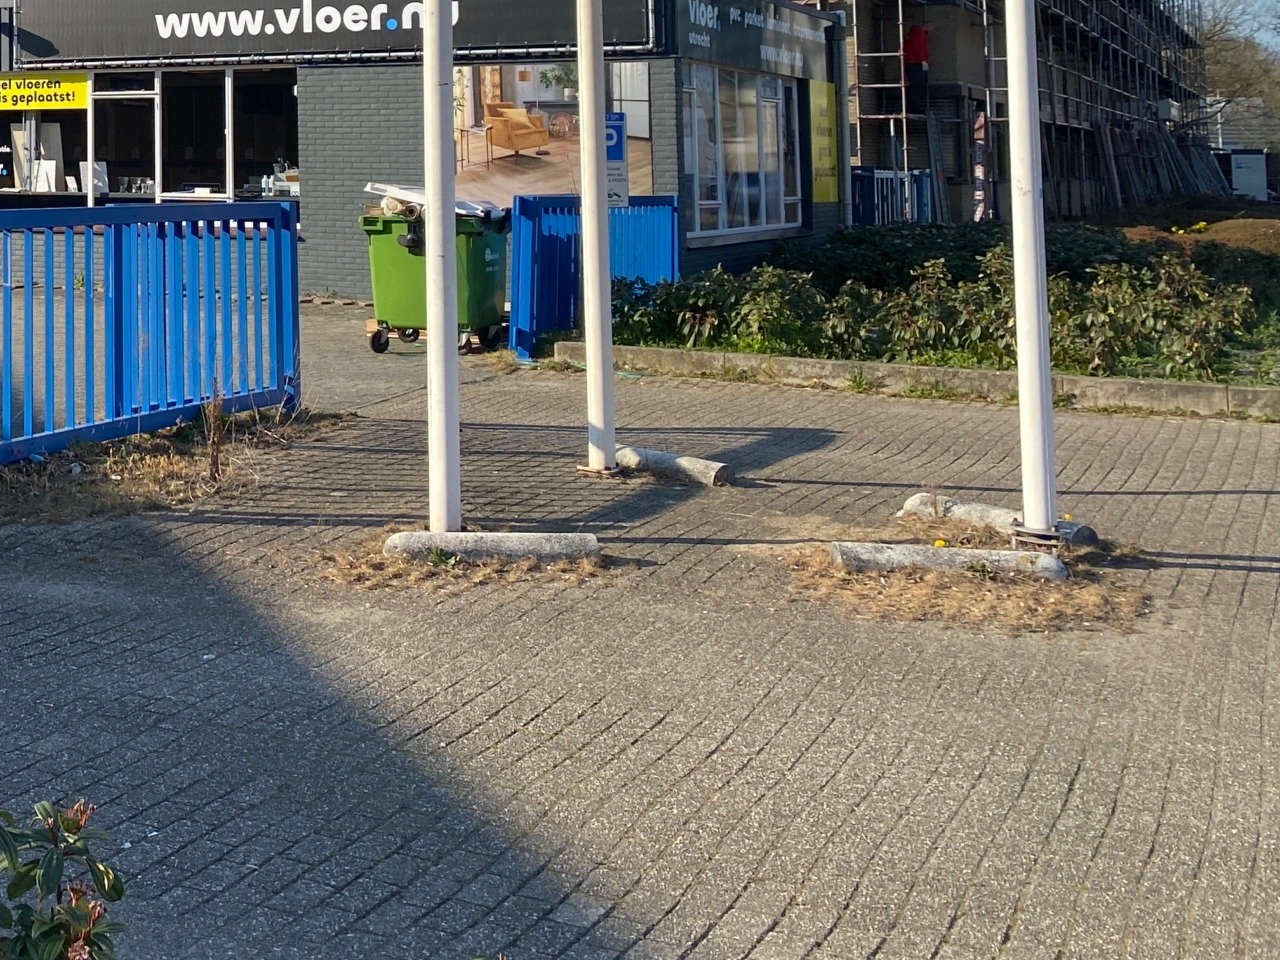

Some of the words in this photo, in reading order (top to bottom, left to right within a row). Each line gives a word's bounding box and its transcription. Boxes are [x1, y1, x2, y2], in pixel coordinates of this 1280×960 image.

[688, 31, 711, 48] utrecht
[15, 78, 61, 90] vloeren
[11, 91, 76, 106] geplaatst!
